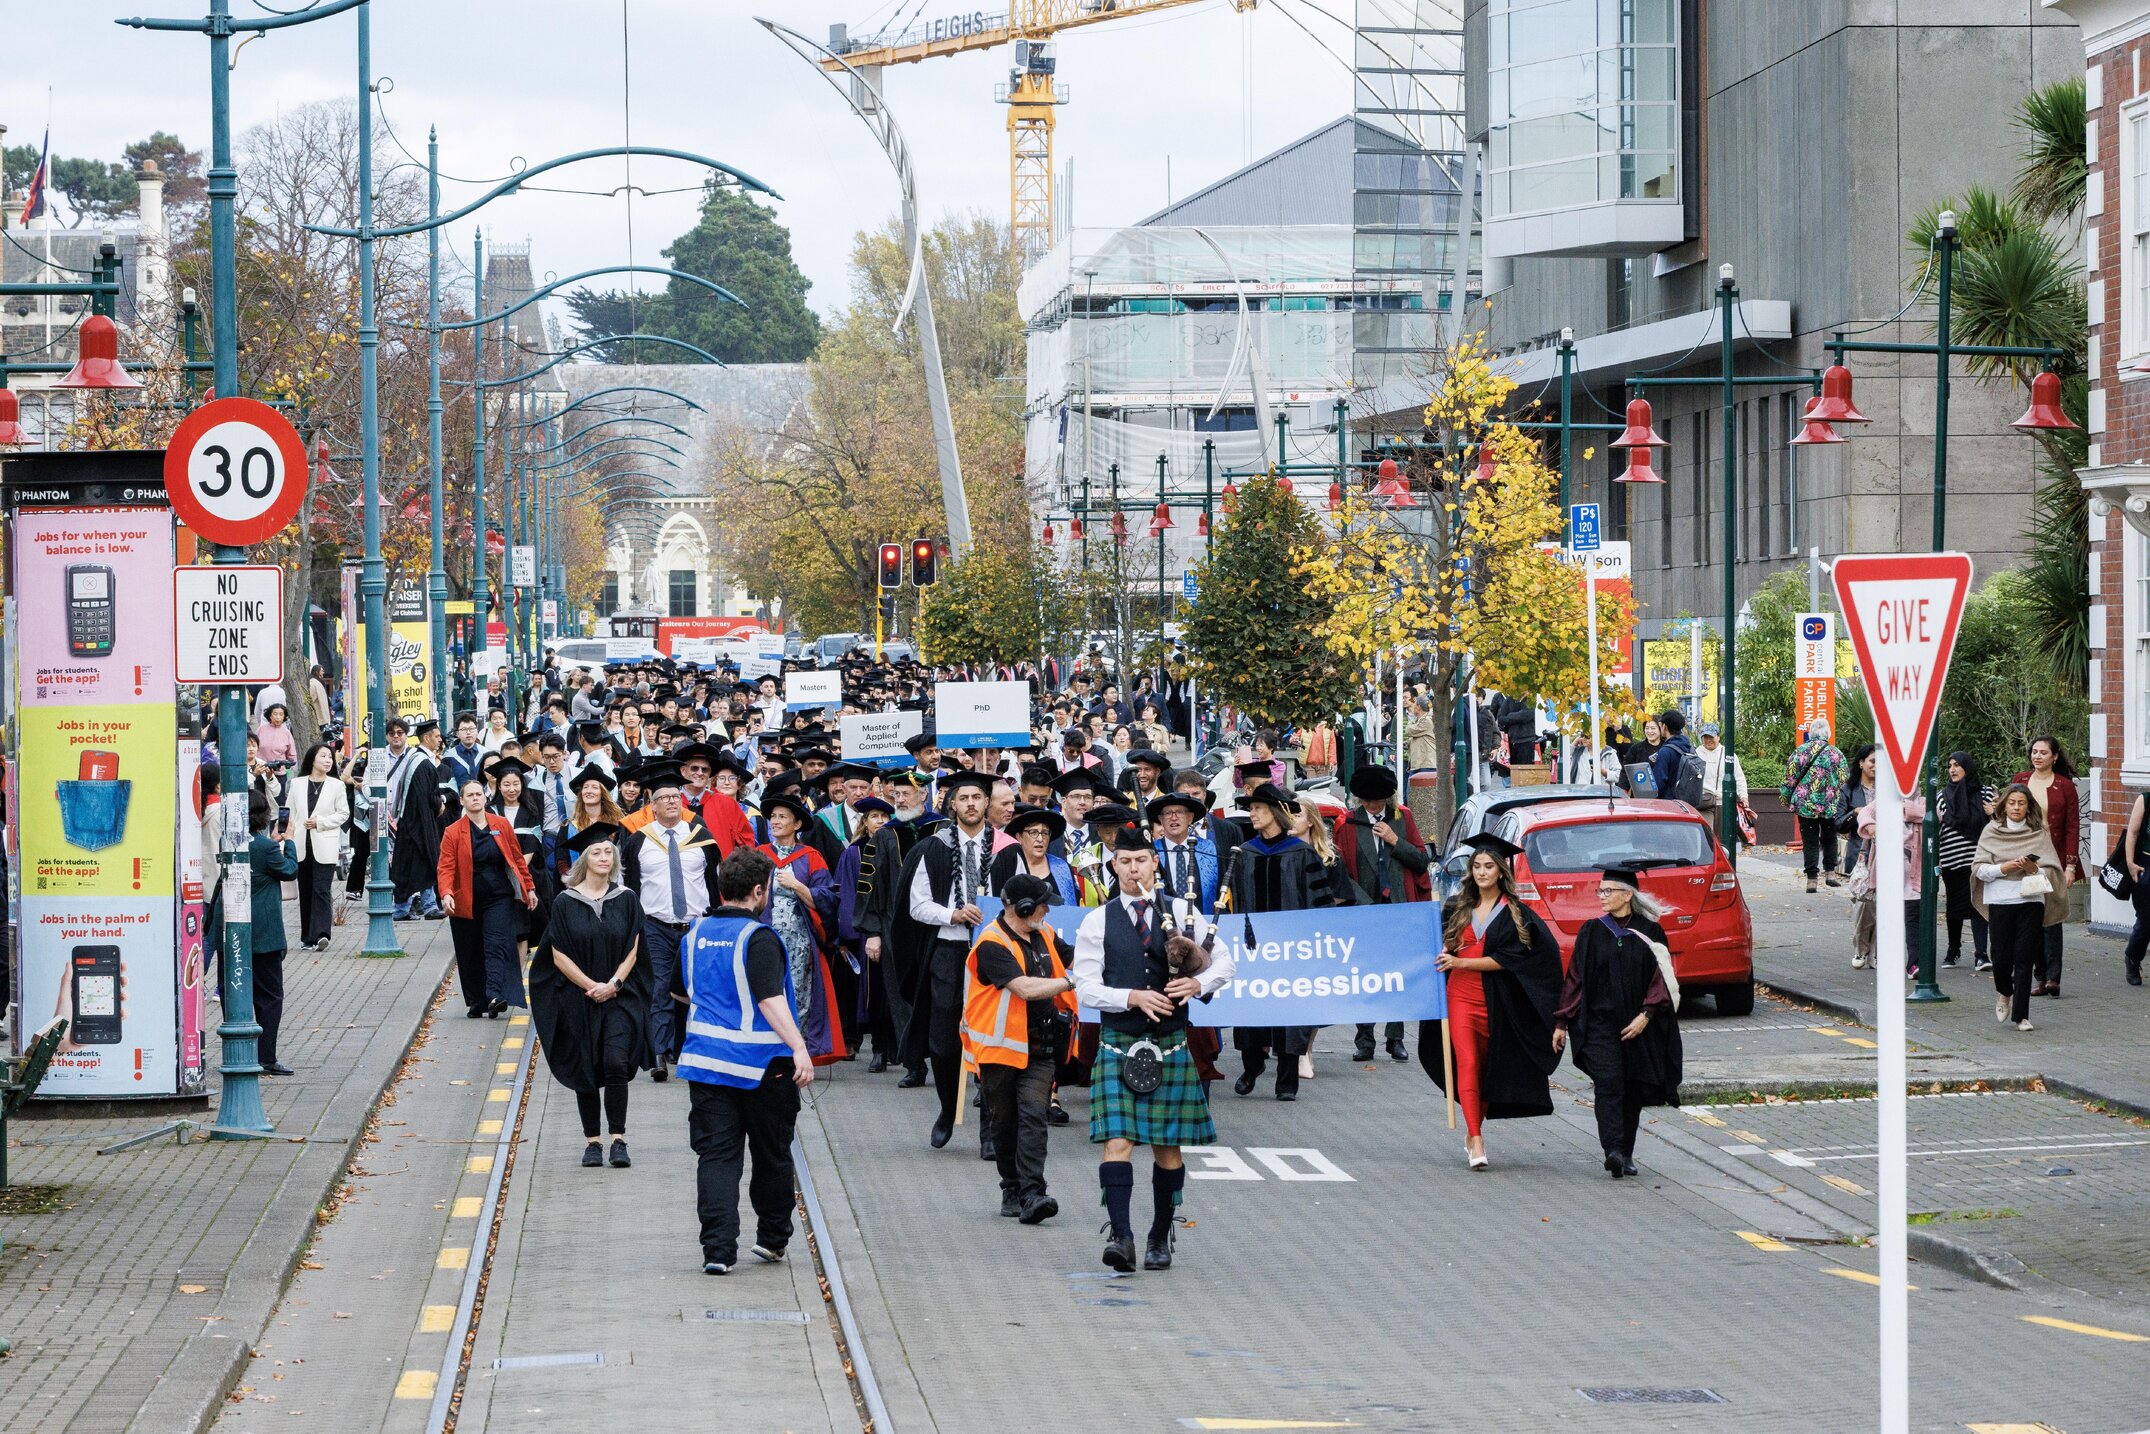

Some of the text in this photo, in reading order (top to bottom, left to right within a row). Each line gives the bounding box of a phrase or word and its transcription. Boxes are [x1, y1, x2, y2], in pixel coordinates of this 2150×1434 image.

[925, 11, 983, 40] LEIGHS
[199, 444, 275, 499] 30
[22, 490, 70, 500] PHANTOM
[138, 489, 169, 499] PHANT
[1579, 522, 1592, 532] 120
[34, 531, 148, 542] Jobs for when your
[46, 543, 134, 555] balance is low.
[1572, 554, 1622, 566] Wlson
[217, 574, 238, 595] NO
[191, 601, 265, 622] CRUISING
[706, 620, 731, 628] Journey
[1878, 598, 1930, 645] GIVE
[1805, 623, 1824, 635] CP
[209, 628, 248, 649] ZONE
[390, 640, 422, 663] gley
[1806, 643, 1816, 674] PARK
[209, 655, 249, 676] ENDS
[36, 674, 100, 684] Get the app!
[1888, 664, 1922, 700] WAY
[404, 686, 423, 697] shot
[1804, 680, 1814, 729] PARKING
[1816, 680, 1826, 720] PUBLIC
[57, 720, 132, 732] Jobs in your
[70, 734, 117, 746] pocket!
[866, 732, 898, 742] Applied
[858, 740, 905, 750] Computing
[1637, 773, 1645, 782] P
[38, 866, 100, 878] Get the app!
[40, 913, 150, 926] Jobs in the palm of
[61, 927, 125, 940] your hand.
[1231, 932, 1356, 964] iversity
[57, 1058, 101, 1069] the app!
[1180, 1146, 1357, 1182] 30
